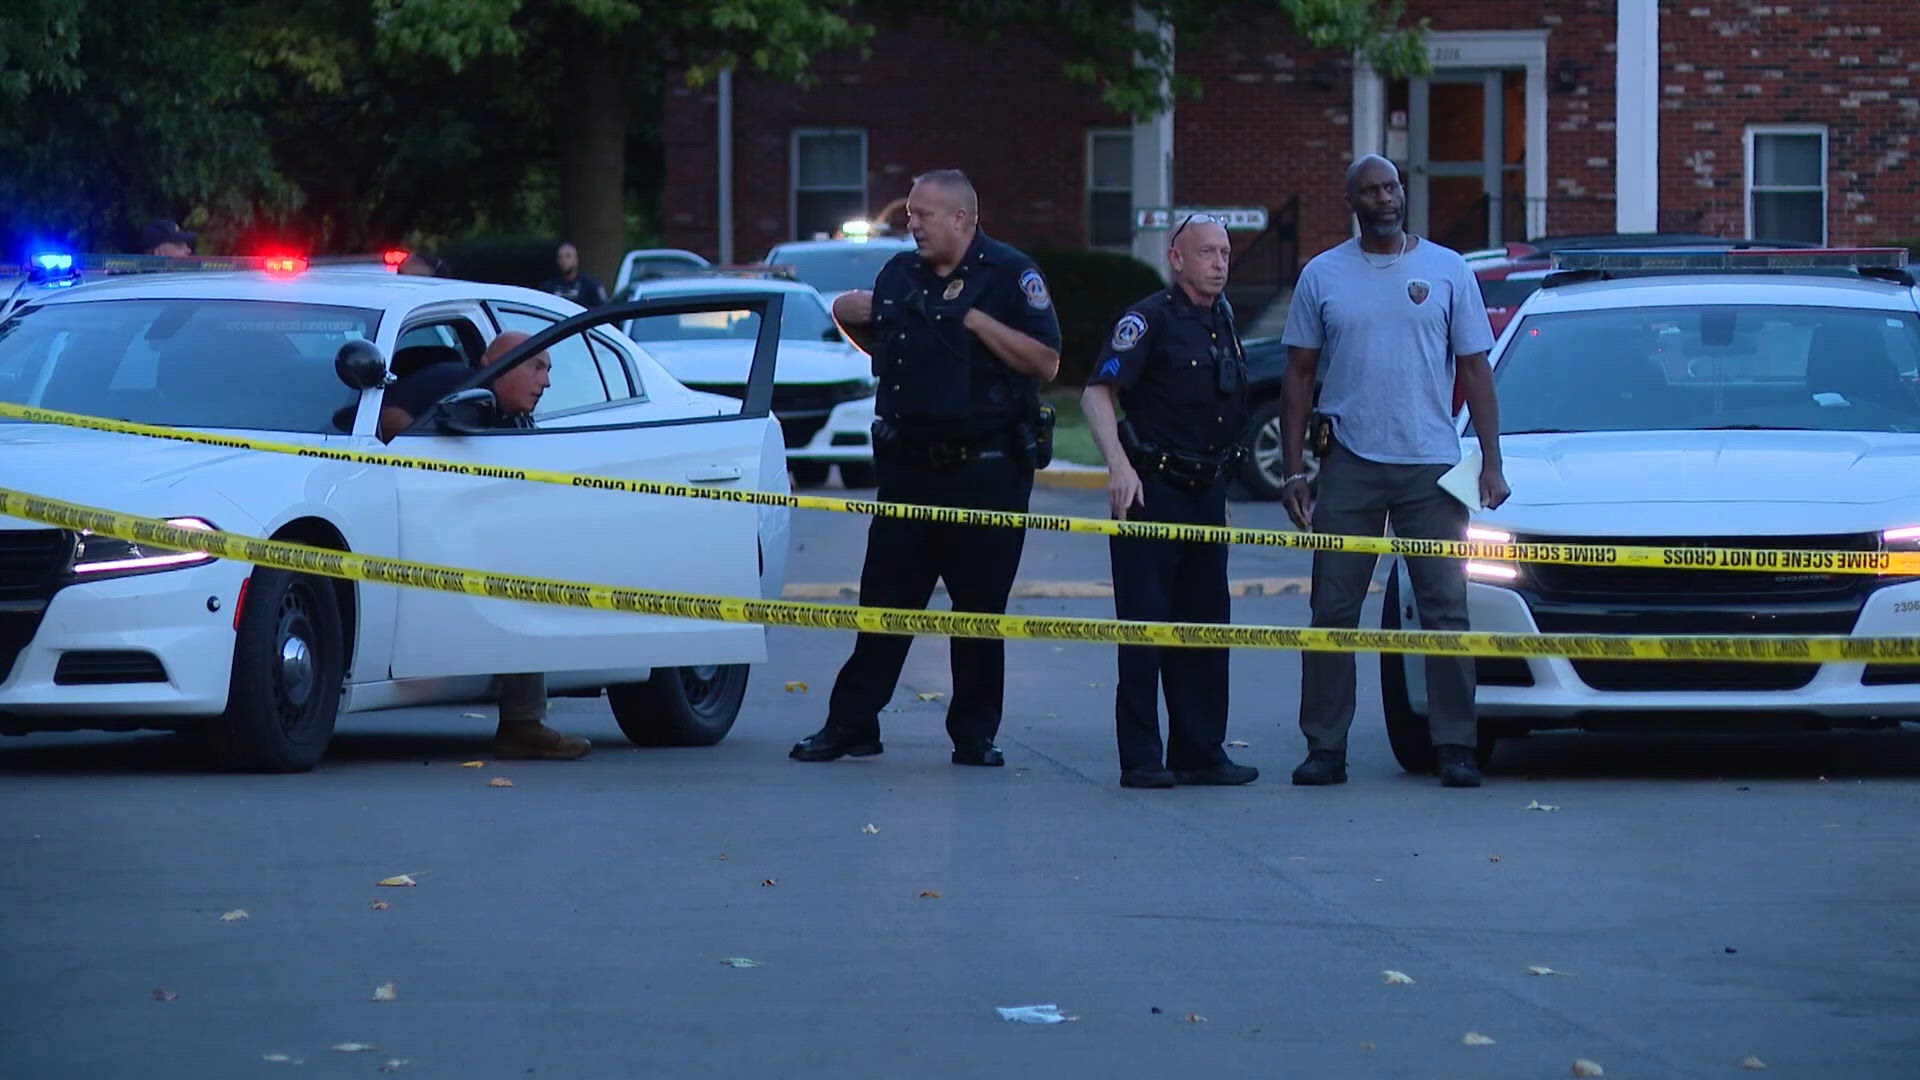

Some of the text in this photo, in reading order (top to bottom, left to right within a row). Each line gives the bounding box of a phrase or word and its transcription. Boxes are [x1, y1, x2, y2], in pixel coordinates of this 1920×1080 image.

[845, 501, 1071, 531] CRIME SCENE DO NOT CROSS
[1117, 523, 1343, 549] CRIME SCENE DO NOT CROSS
[1391, 539, 1444, 555] CROSS
[1449, 541, 1479, 557] NOT
[1482, 543, 1505, 558] DO
[1508, 544, 1560, 560] SCENE
[1564, 546, 1617, 563] CRIME
[1664, 549, 1716, 566] CROSS
[1720, 550, 1751, 567] NOT
[1756, 551, 1778, 567] DO
[1781, 551, 1833, 568] SCENE
[1837, 552, 1890, 569] CRIME
[1893, 600, 1920, 613] 2306
